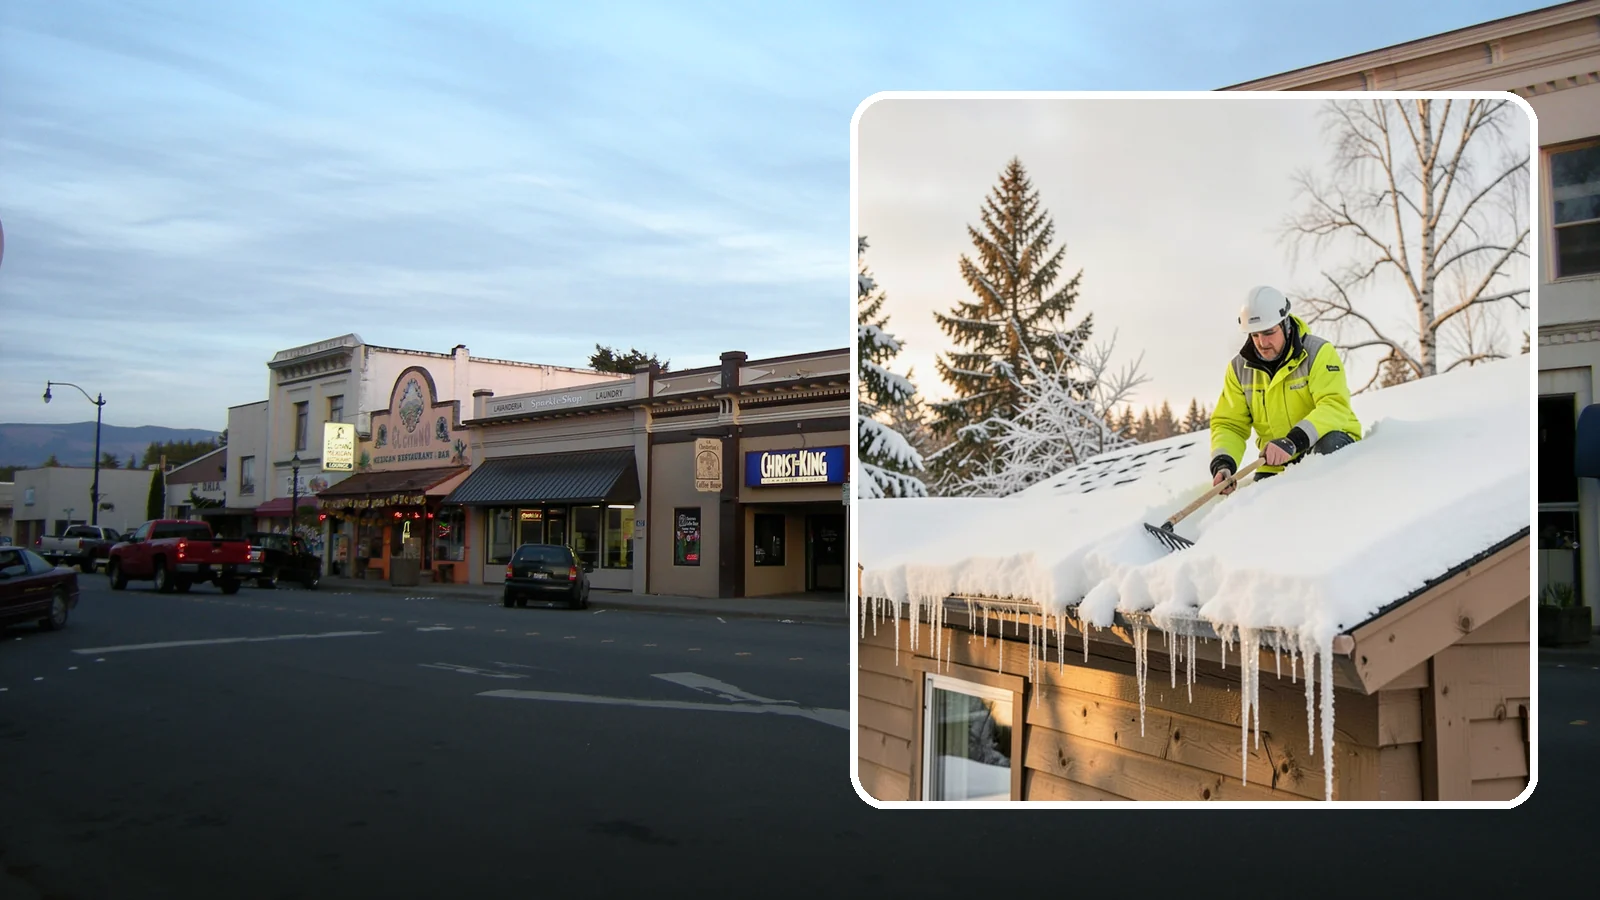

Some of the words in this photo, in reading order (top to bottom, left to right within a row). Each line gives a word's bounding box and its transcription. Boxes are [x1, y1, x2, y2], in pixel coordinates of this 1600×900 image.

[561, 394, 582, 406] Shop
[595, 388, 623, 400] LAUNDRY
[493, 402, 522, 413] LAVANDERIA
[397, 451, 433, 462] RESTAURANT
[437, 450, 449, 459] BAR
[761, 452, 797, 478] CHRIST
[799, 450, 827, 476] KING
